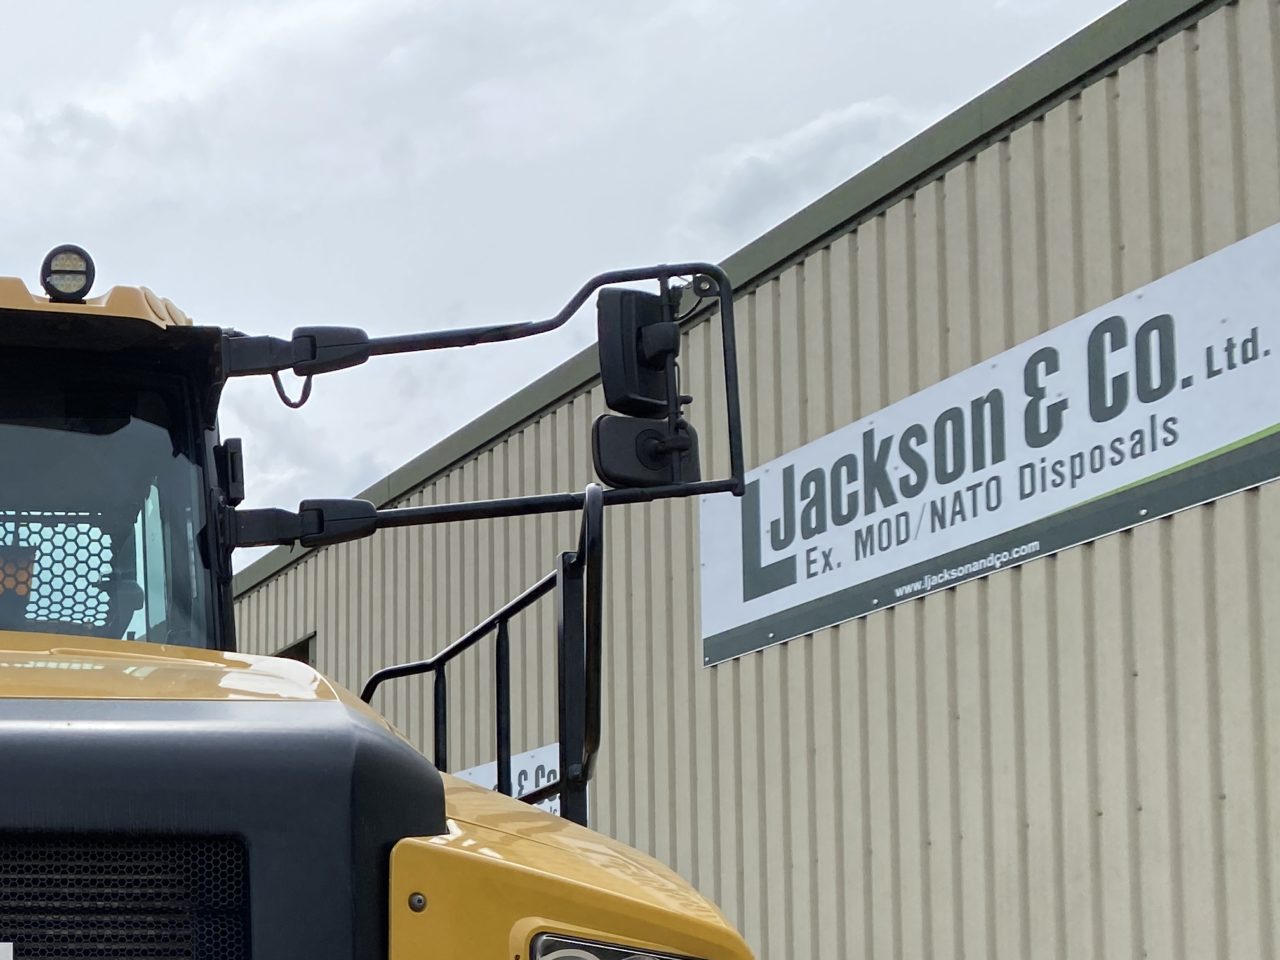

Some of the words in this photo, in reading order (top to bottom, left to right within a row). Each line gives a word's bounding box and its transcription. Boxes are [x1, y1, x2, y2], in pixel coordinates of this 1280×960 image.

[1023, 346, 1069, 449] &
[1087, 313, 1195, 423] Co.
[1205, 326, 1271, 380] Ltd.
[805, 545, 842, 580] Ex.
[854, 475, 1003, 562] MOD/NATO
[1019, 413, 1180, 501] Disposals
